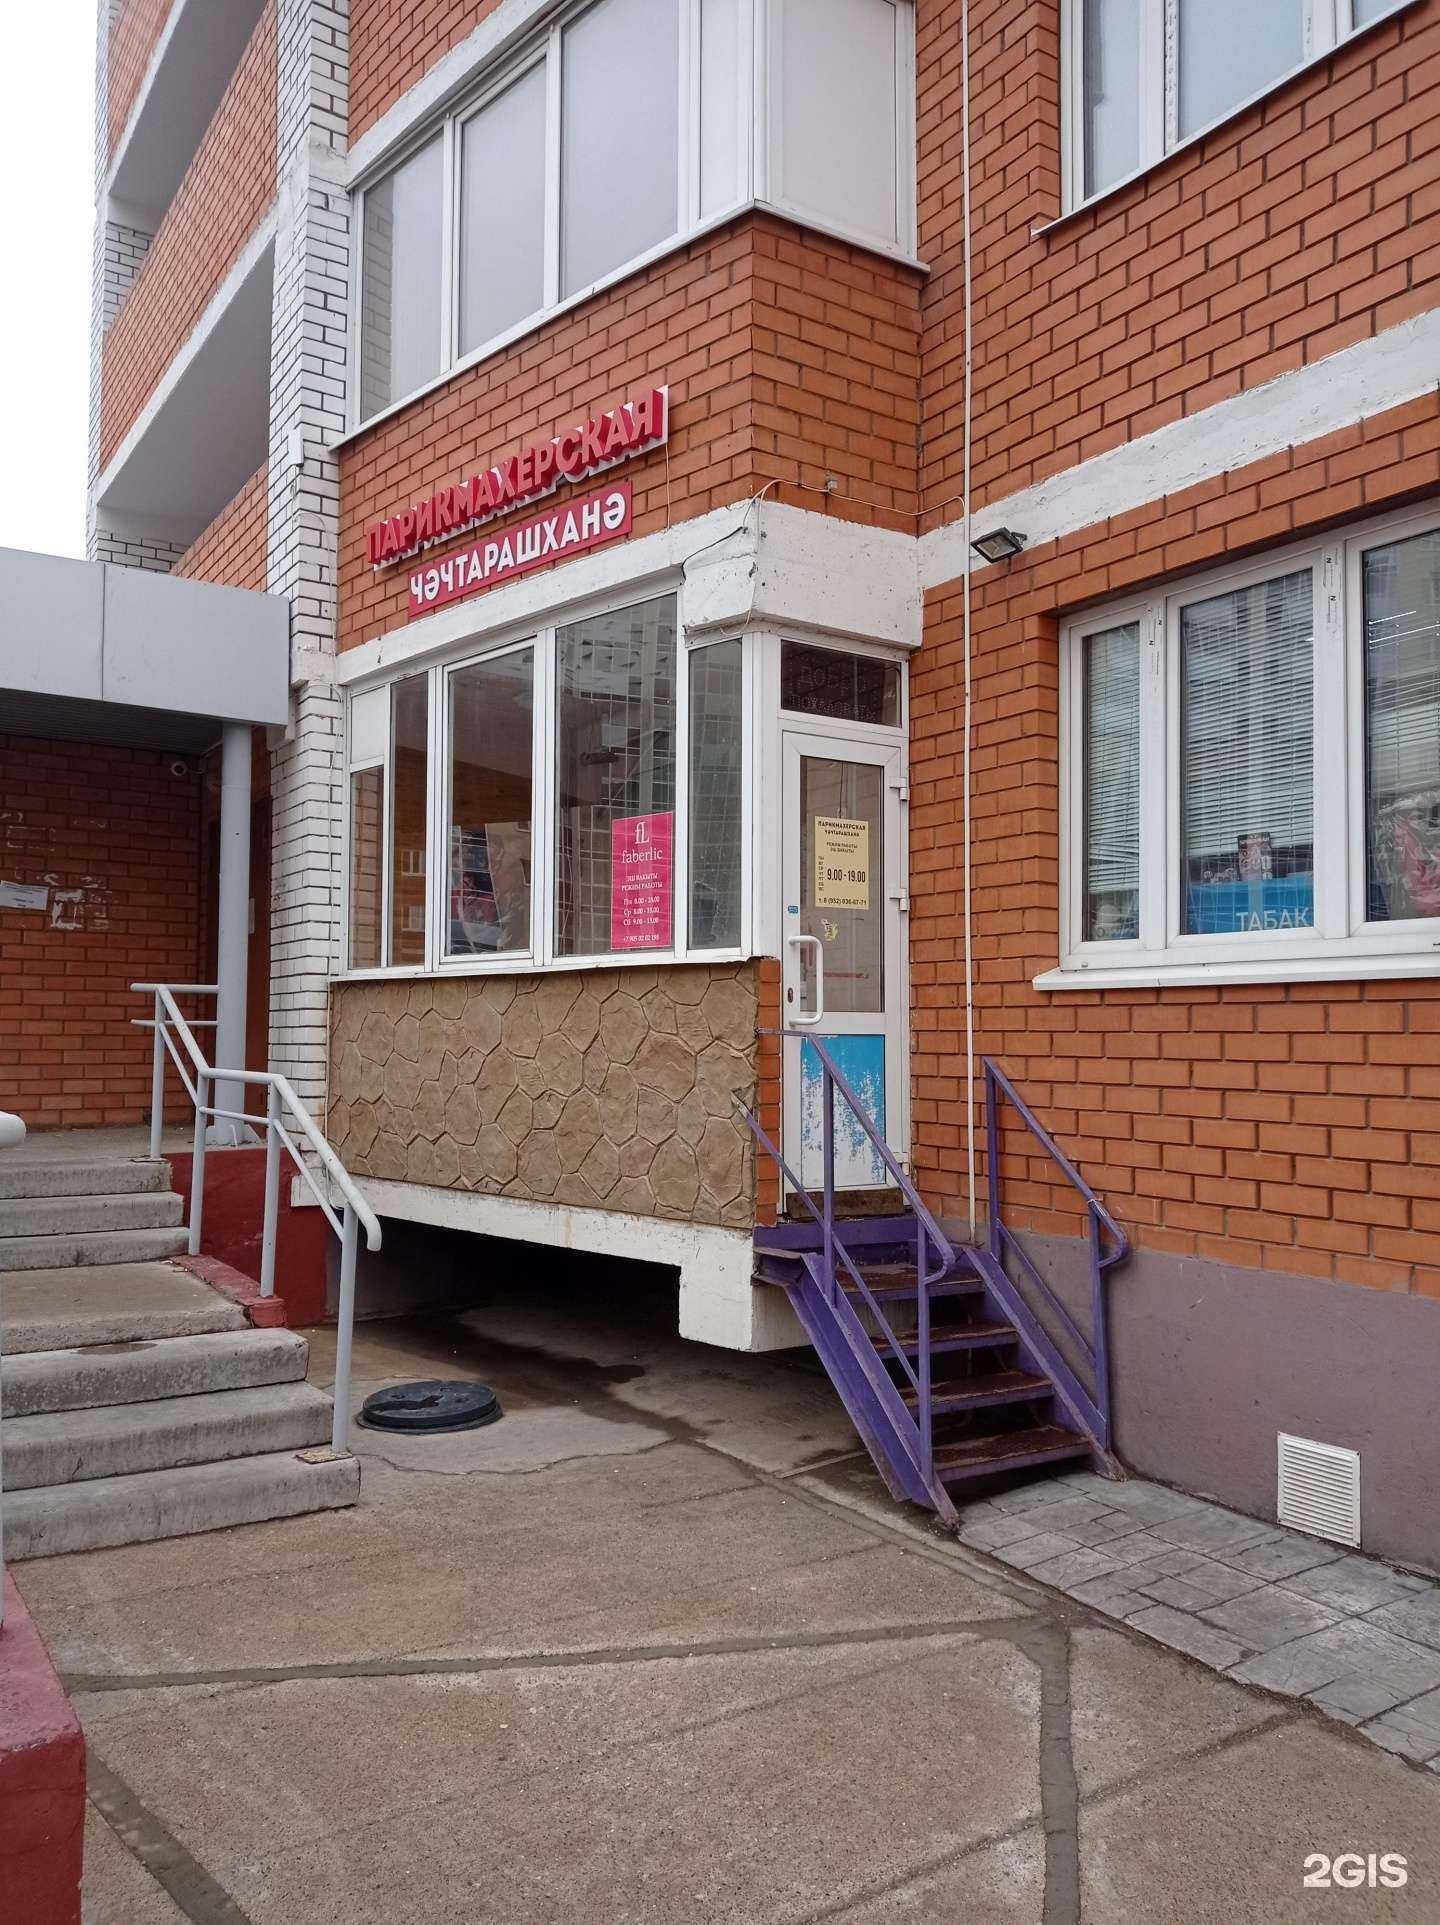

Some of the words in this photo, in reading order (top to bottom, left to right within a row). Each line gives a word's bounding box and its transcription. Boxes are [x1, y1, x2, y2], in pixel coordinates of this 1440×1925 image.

[366, 386, 668, 569] ПАРИКМАХЕРСКАЯ
[410, 492, 626, 604] ЧӘЧТАРАШХАНӘ
[818, 820, 866, 831] ПАРИКМАХЕРСКАЯ
[621, 846, 663, 864] faberlic
[827, 868, 843, 881] 9.00
[848, 870, 866, 883] 19.00
[621, 884, 641, 892] РЕЖИМ
[641, 881, 663, 890] РАБОТЫ
[1235, 906, 1311, 932] ТАБАК
